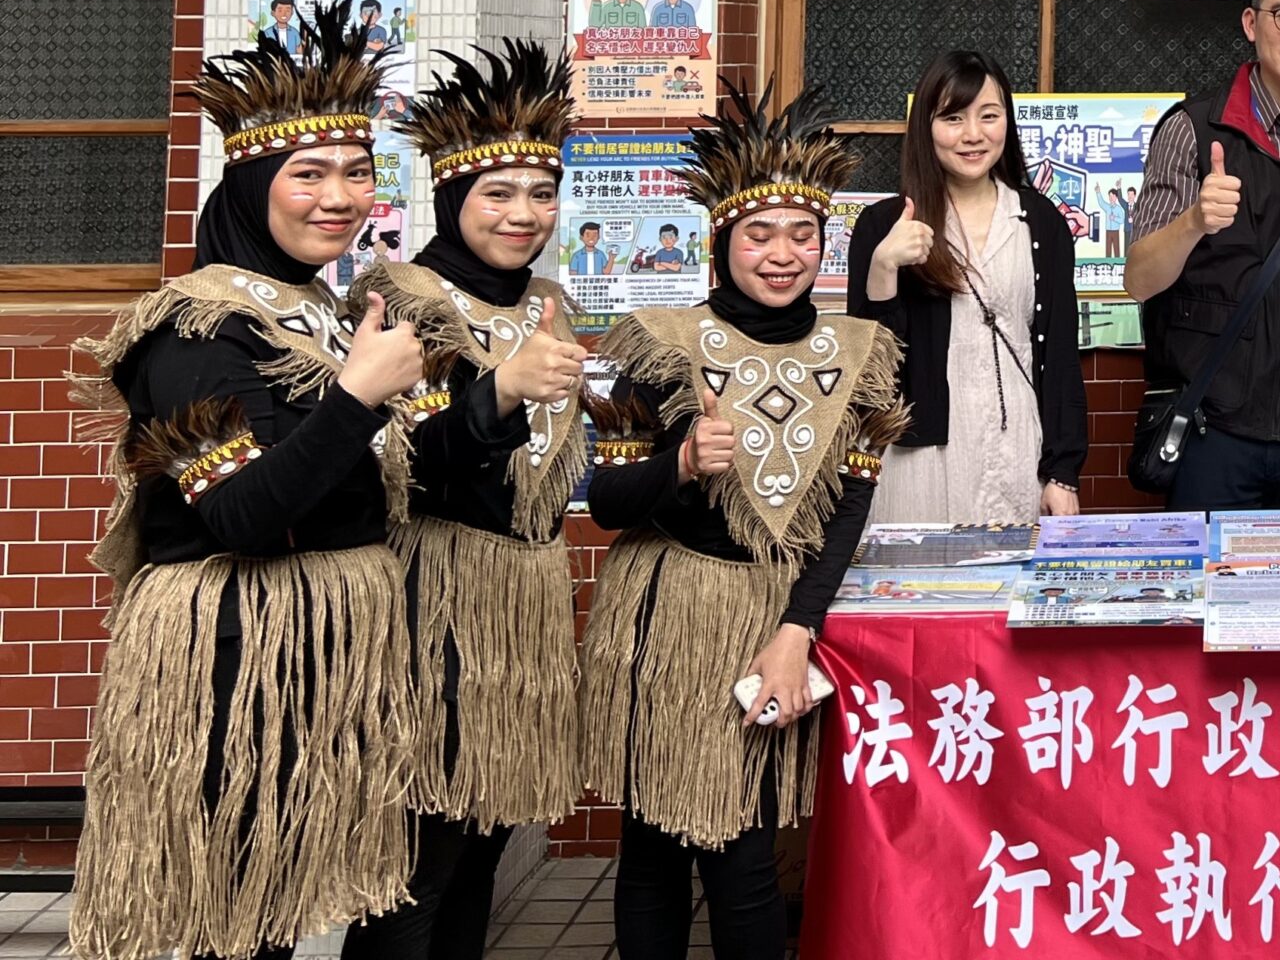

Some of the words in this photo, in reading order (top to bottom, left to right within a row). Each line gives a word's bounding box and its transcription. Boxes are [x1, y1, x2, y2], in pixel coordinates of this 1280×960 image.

[1017, 105, 1079, 121] 反賄選宣導
[571, 142, 694, 155] 不要借居留證給朋友買
[572, 170, 635, 182] 真心好朋友
[572, 185, 634, 197] 名字借他人
